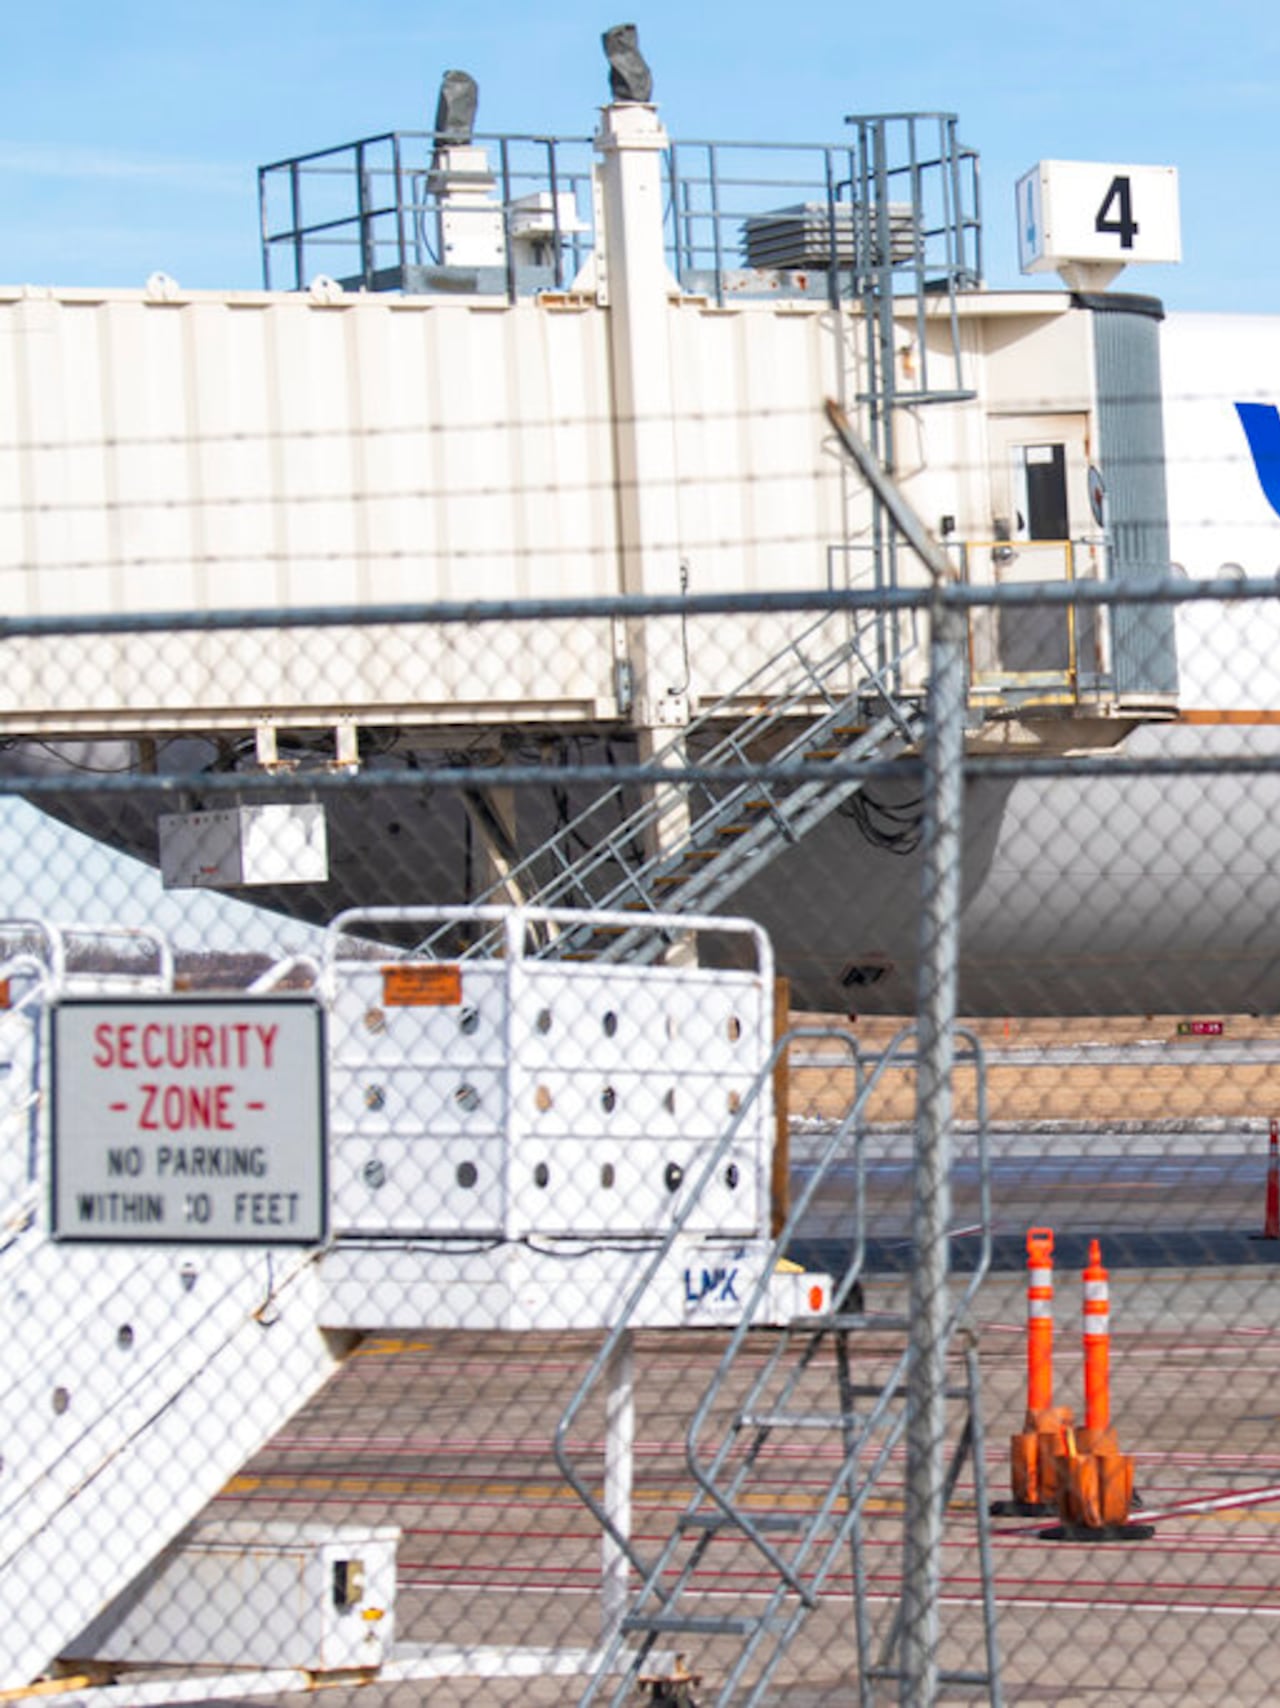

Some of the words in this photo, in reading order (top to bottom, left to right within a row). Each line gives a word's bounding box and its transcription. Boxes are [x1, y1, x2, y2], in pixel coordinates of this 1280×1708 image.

[1094, 175, 1139, 249] 4
[93, 1023, 279, 1069] SECURITY
[107, 1147, 143, 1177] NO
[157, 1147, 268, 1177] PARKING
[77, 1193, 164, 1223] WITHIN
[234, 1193, 299, 1224] FEET
